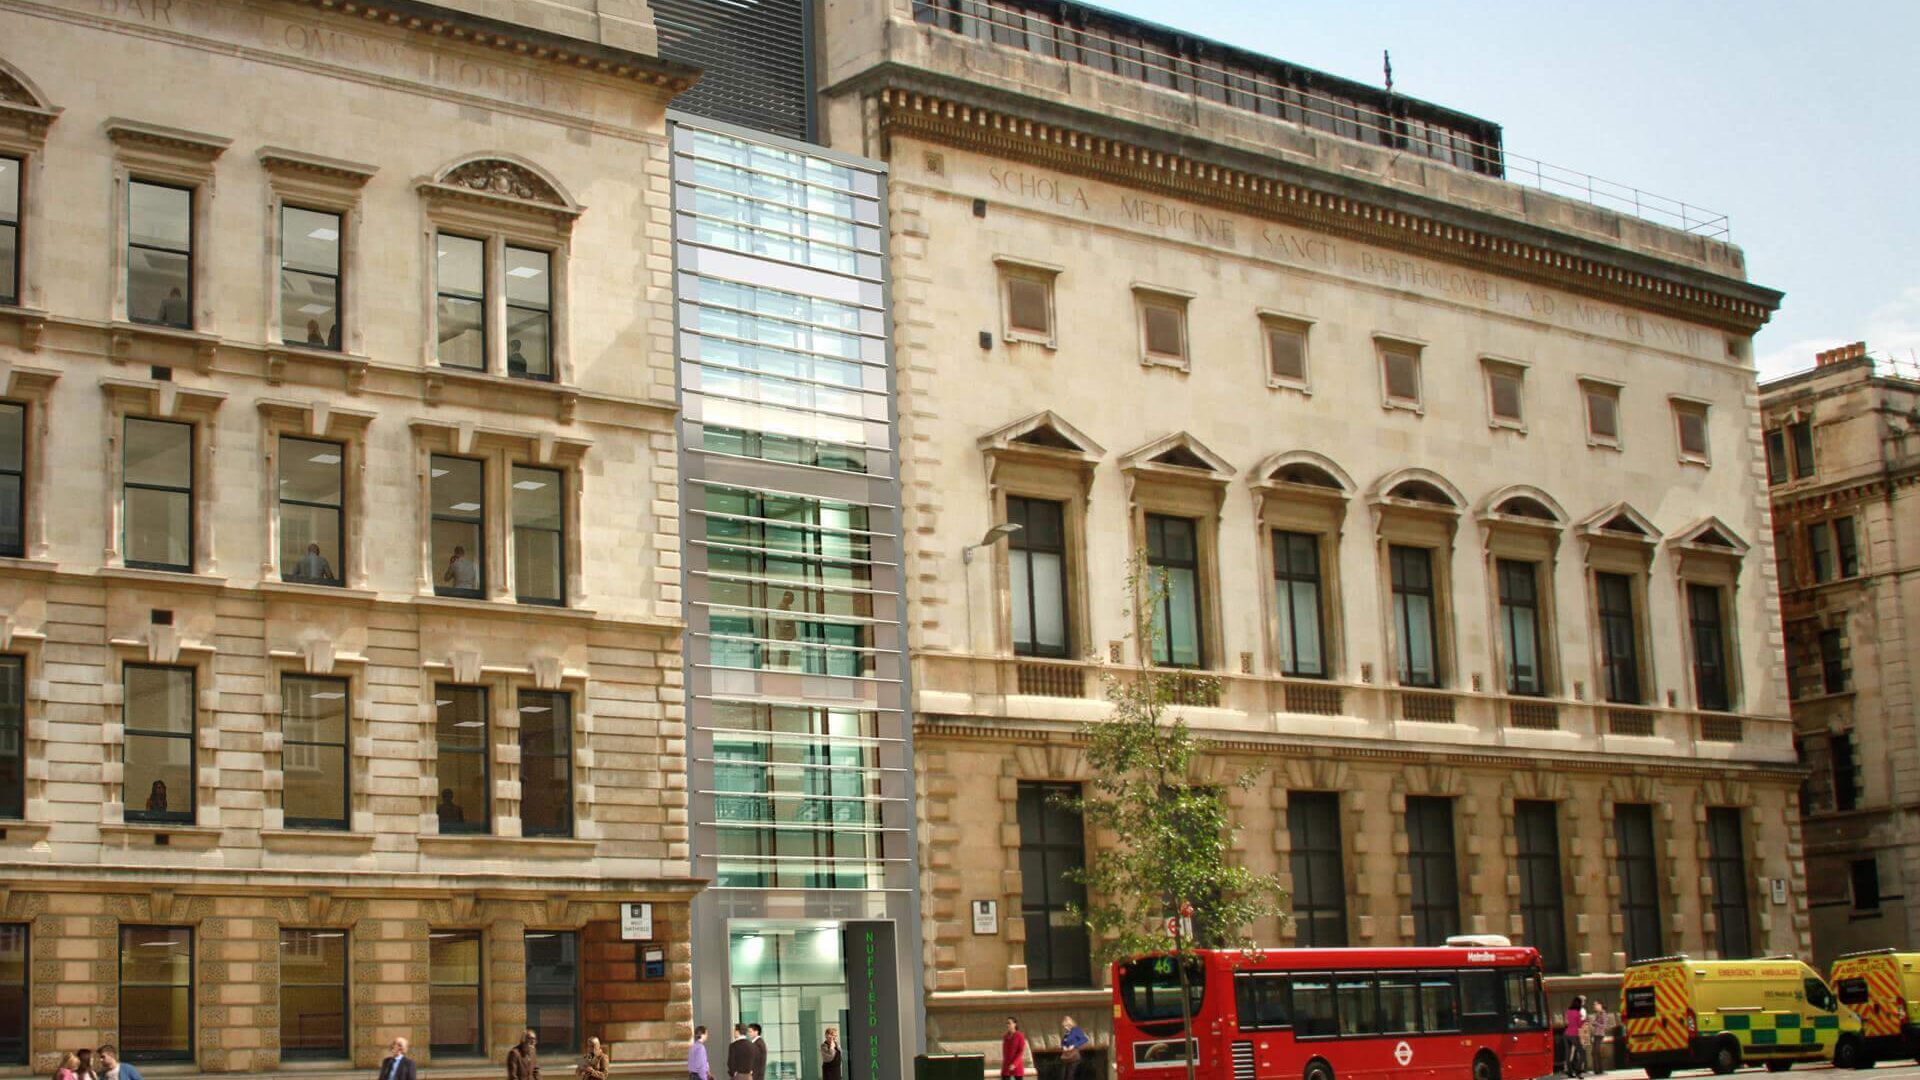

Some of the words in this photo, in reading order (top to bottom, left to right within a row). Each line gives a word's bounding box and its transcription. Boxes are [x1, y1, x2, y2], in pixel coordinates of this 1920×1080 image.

[988, 166, 1090, 210] SCHOLA
[1262, 228, 1338, 266] SANCTI
[865, 930, 877, 1027] NUFFIELD
[1154, 958, 1171, 974] 46
